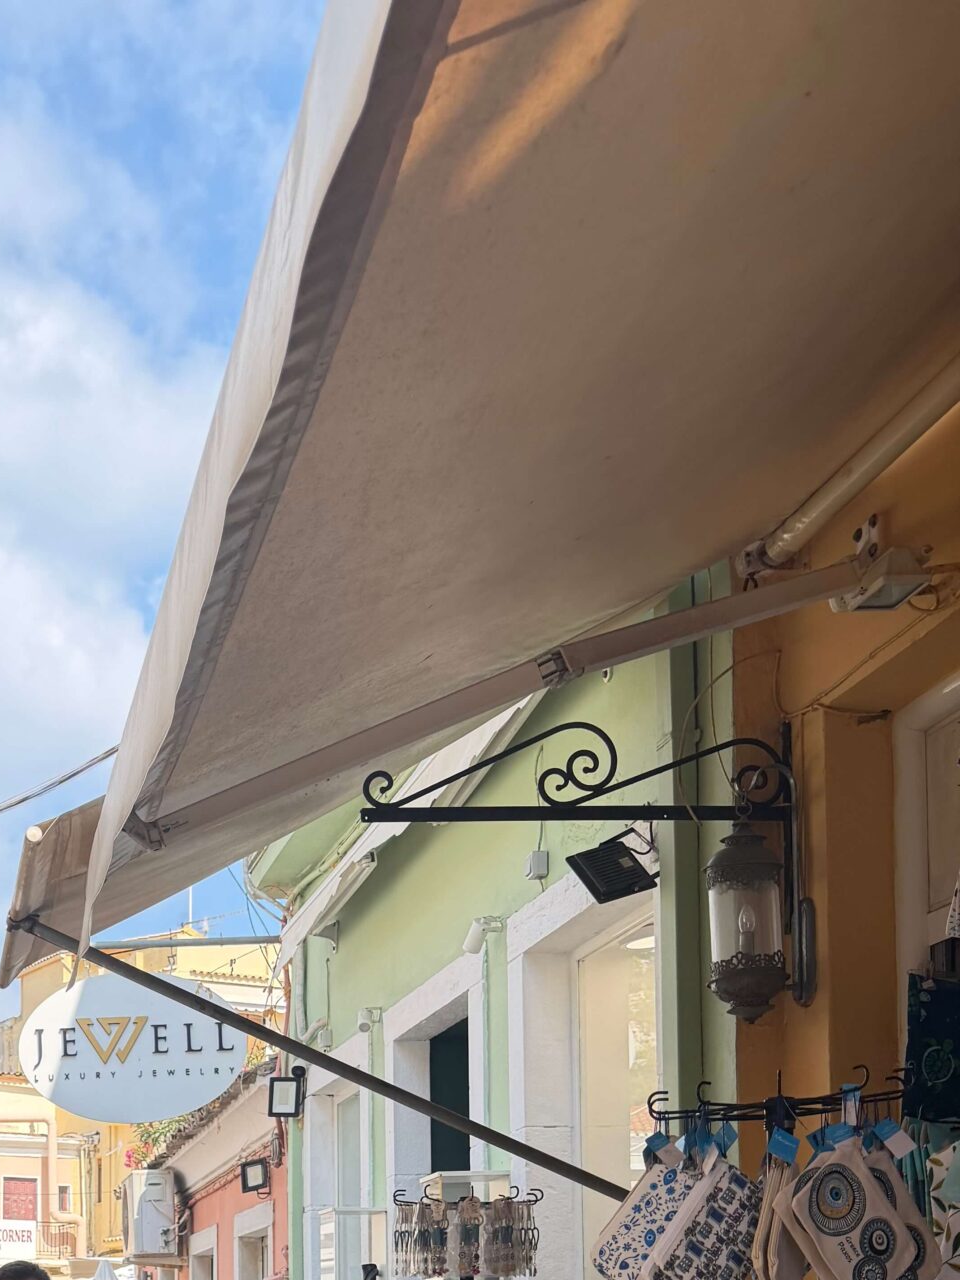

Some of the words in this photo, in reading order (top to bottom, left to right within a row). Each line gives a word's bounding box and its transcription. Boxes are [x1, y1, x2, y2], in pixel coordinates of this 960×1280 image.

[32, 1015, 235, 1071] JEWELL
[33, 1071, 117, 1083] LUXURY
[137, 1066, 236, 1079] JEWELRY
